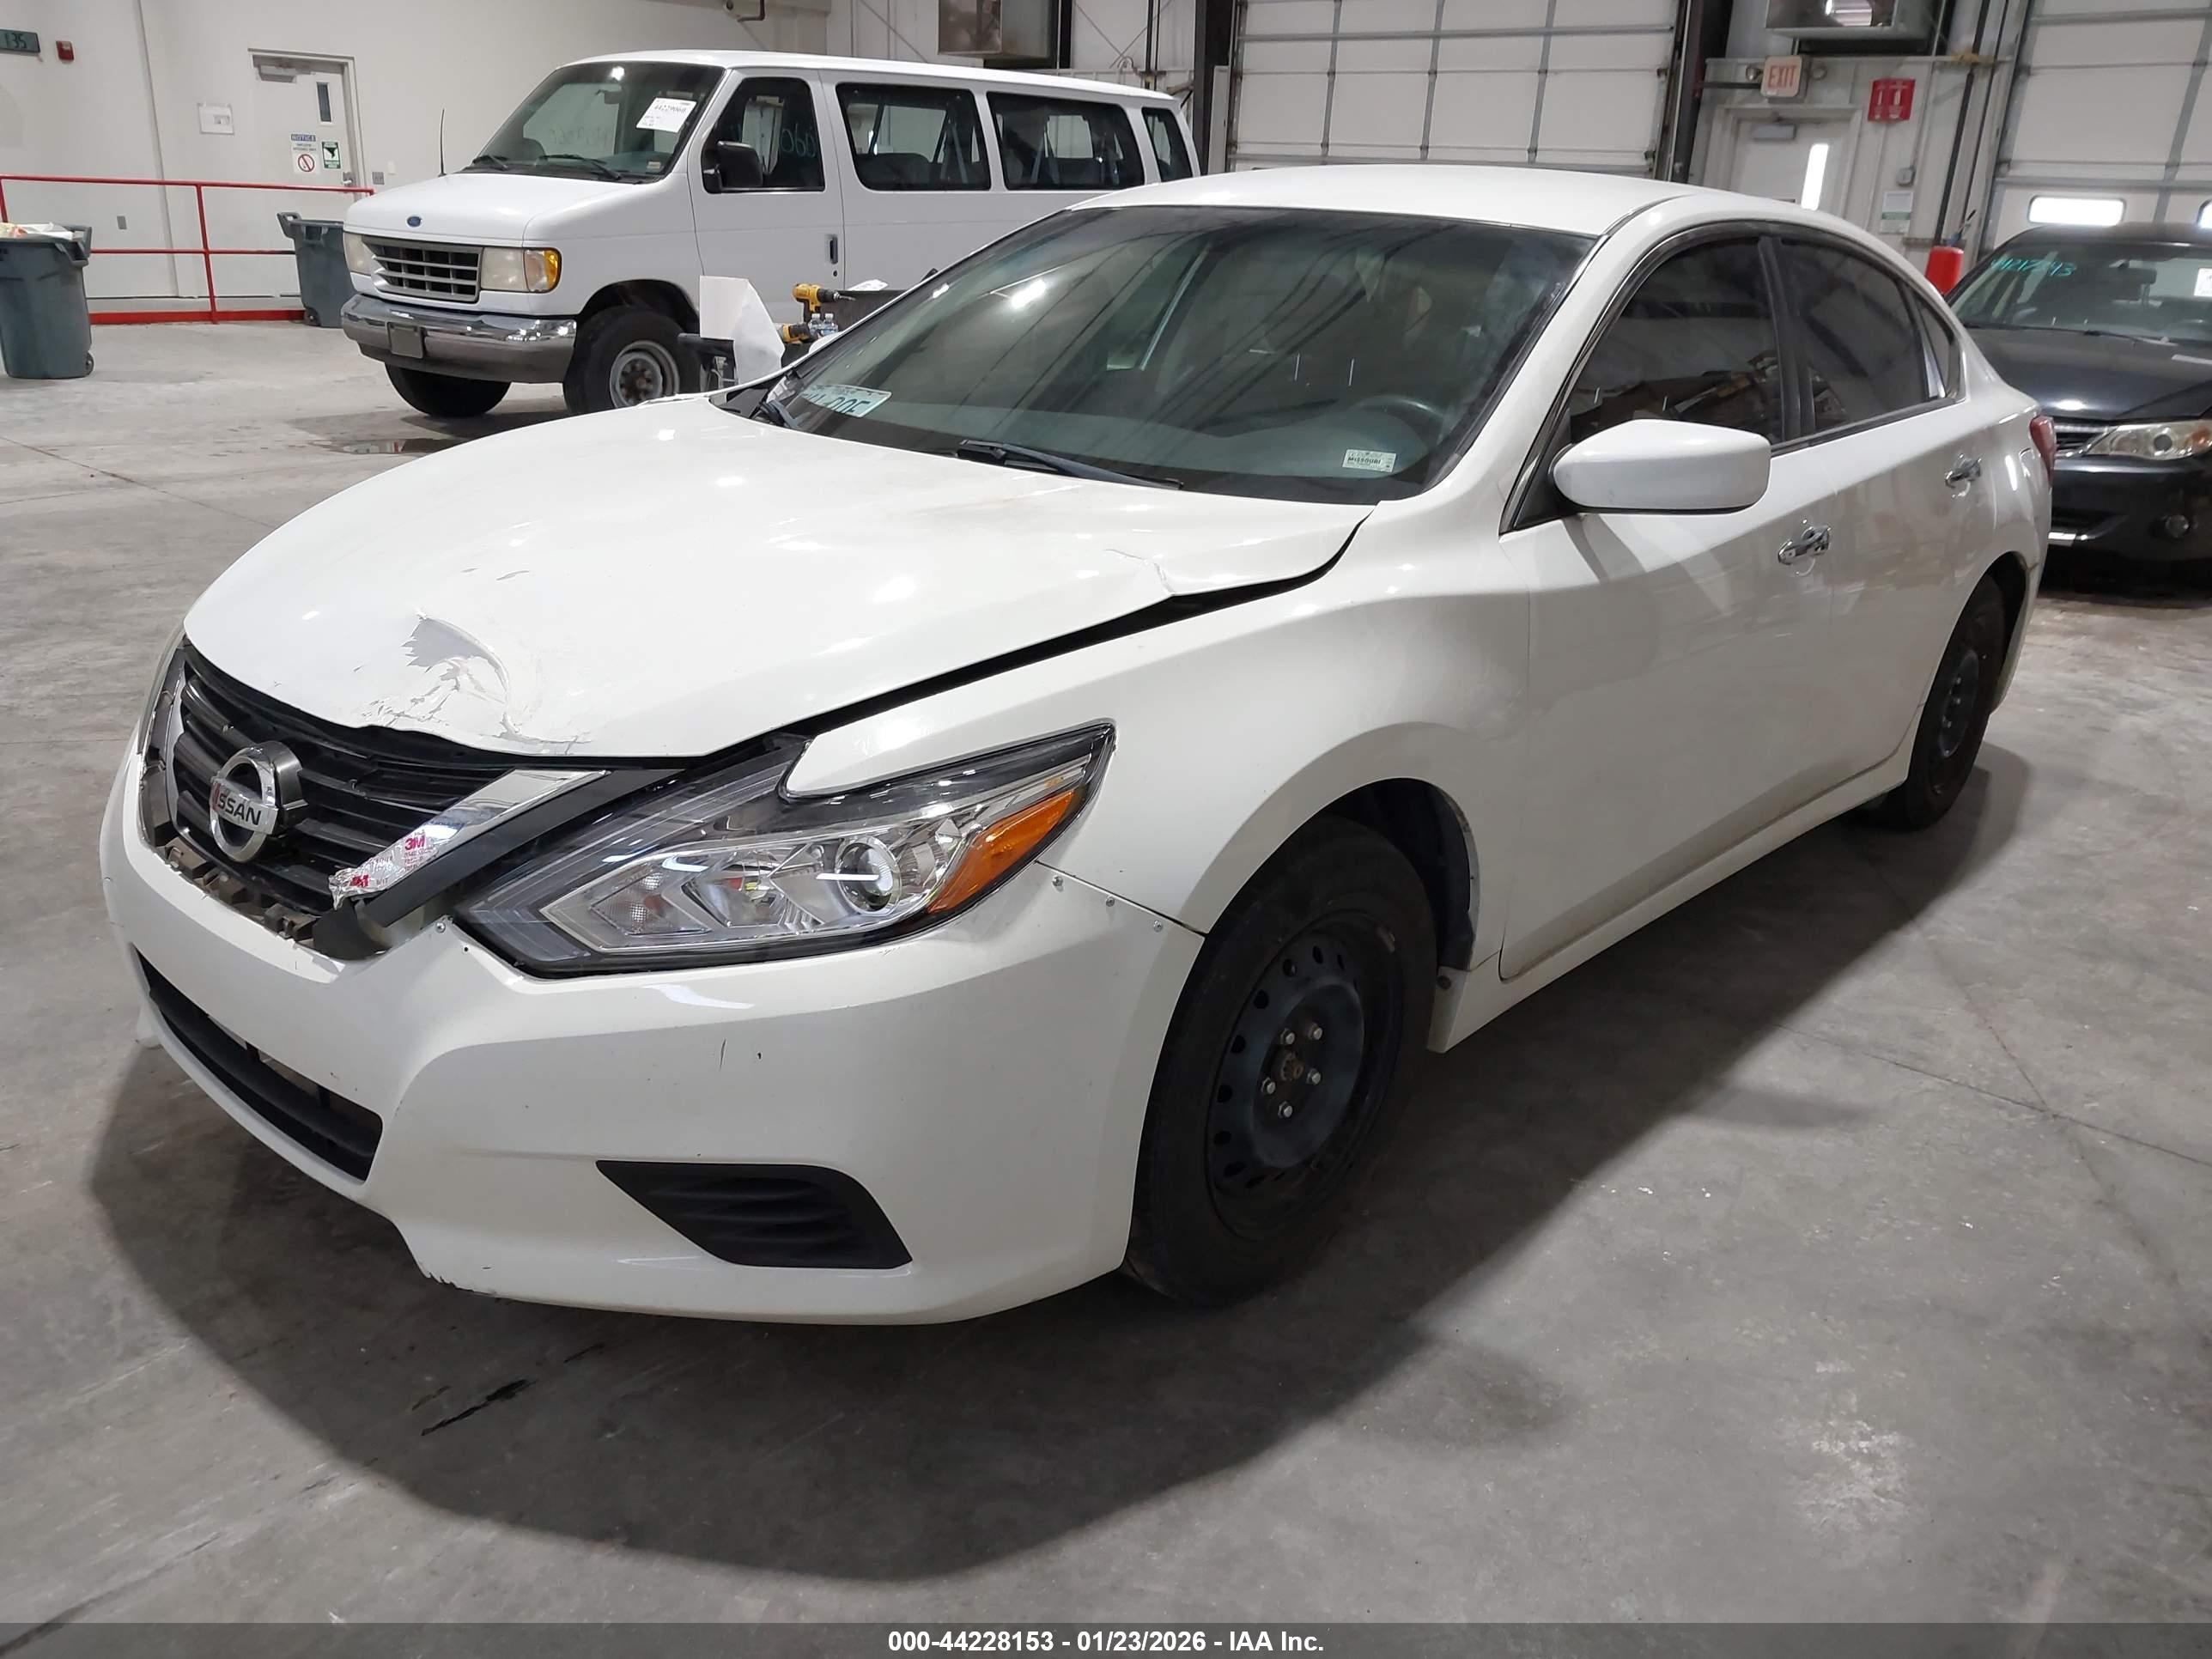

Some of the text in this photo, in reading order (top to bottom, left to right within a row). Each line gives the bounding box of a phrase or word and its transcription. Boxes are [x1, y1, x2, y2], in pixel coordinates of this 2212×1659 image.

[1768, 64, 1797, 88] EXIT
[1347, 456, 1382, 465] MISSOURI
[404, 835, 426, 851] 3M
